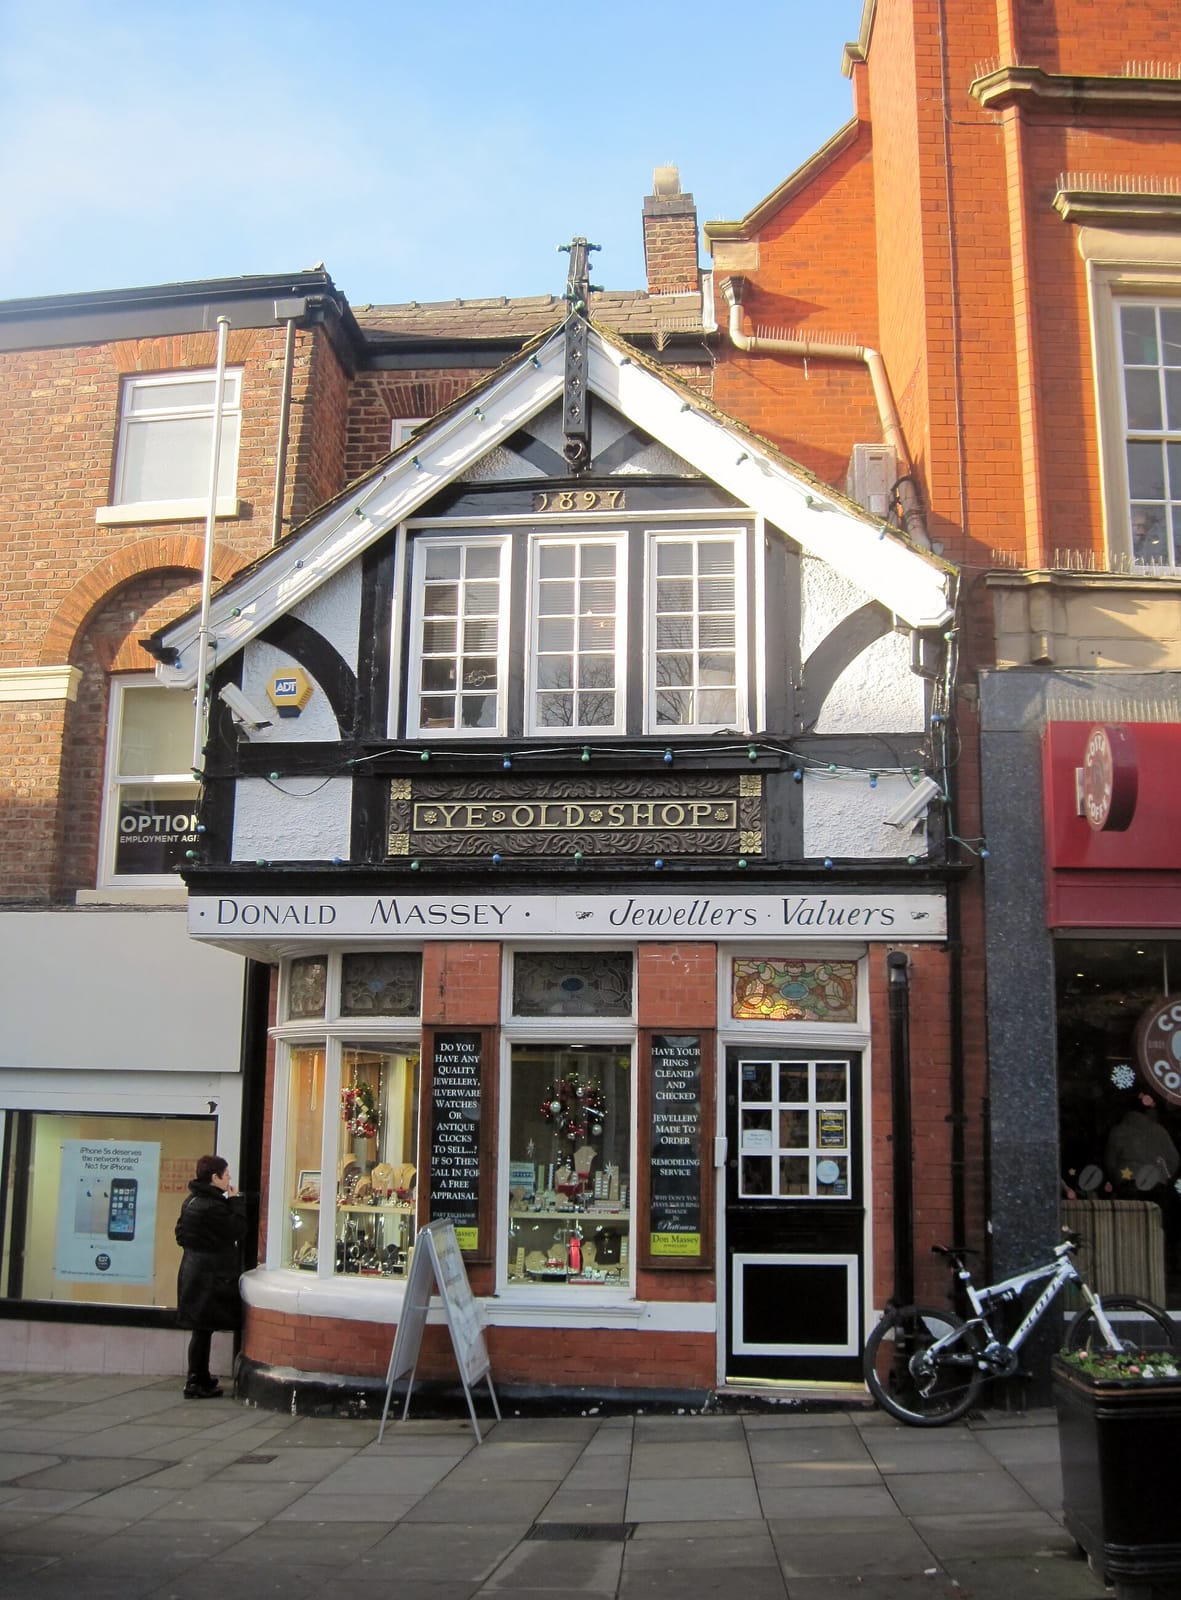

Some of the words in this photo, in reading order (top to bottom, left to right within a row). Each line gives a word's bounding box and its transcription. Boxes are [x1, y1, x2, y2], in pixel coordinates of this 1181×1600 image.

[537, 491, 620, 512] 1897
[276, 682, 297, 692] ADT
[1087, 734, 1106, 767] COSTA
[437, 805, 488, 828] YE
[511, 804, 585, 828] OLD
[607, 803, 712, 827] SHOP
[120, 835, 179, 843] EMPLOYMENT
[217, 898, 337, 925] DONALD
[369, 898, 513, 925] MASSEY
[609, 898, 758, 926] Jewellers
[781, 898, 896, 926] Valuers
[440, 1043, 454, 1051] DO
[456, 1043, 475, 1051] YOU
[651, 1047, 675, 1056] HAVE
[676, 1047, 701, 1056] YOUR
[435, 1054, 459, 1063] HAVE
[460, 1054, 480, 1063] ANY
[662, 1058, 689, 1067] RINGS
[438, 1066, 476, 1075] QUALITY
[655, 1070, 694, 1078] CLEANED
[666, 1081, 686, 1089] AND
[655, 1091, 696, 1100] CHECKED
[435, 1100, 477, 1108] WATCHES
[448, 1111, 462, 1119] OR
[652, 1113, 698, 1123] JEWELLERY
[436, 1123, 475, 1132] ANTIQUE
[655, 1125, 681, 1133] MADE
[681, 1125, 696, 1133] TO
[438, 1134, 472, 1142] CLOCKS
[660, 1136, 690, 1145] ORDER
[80, 1146, 102, 1155] iPhone
[112, 1148, 142, 1156] deserves
[433, 1145, 446, 1153] TO
[82, 1154, 92, 1162] the
[121, 1156, 139, 1164] rated
[431, 1156, 438, 1165] IF
[441, 1157, 452, 1165] SO
[454, 1157, 478, 1165] THEN
[651, 1158, 700, 1166] REMODELING
[451, 1168, 461, 1177] IN
[659, 1168, 692, 1176] SERVICE
[440, 1180, 447, 1188] A
[449, 1180, 469, 1188] FREE
[652, 1234, 669, 1243] Don
